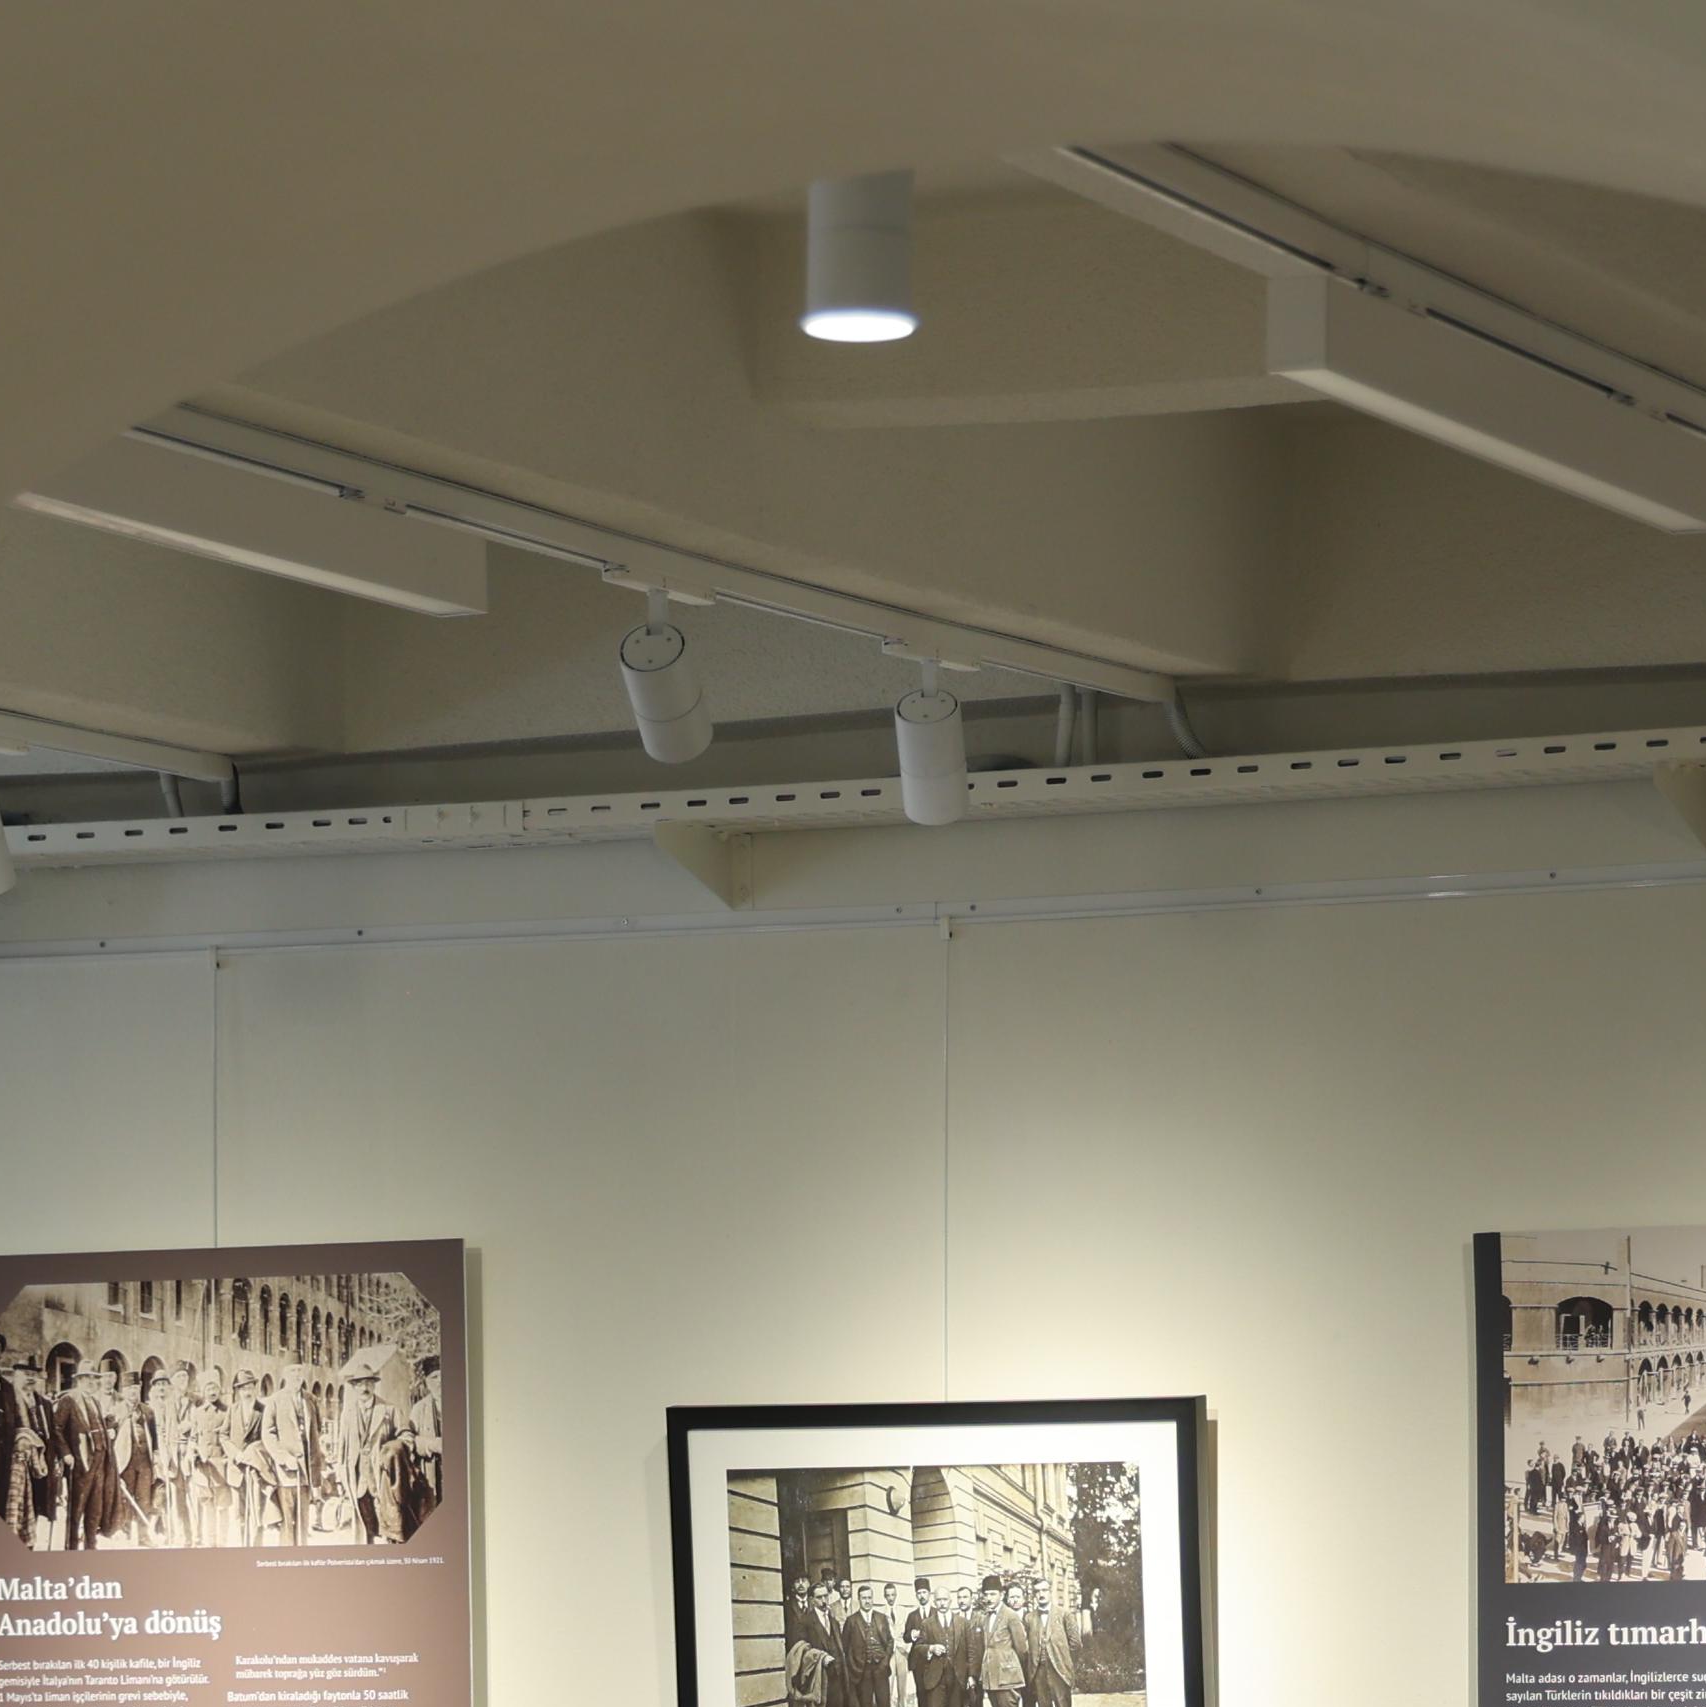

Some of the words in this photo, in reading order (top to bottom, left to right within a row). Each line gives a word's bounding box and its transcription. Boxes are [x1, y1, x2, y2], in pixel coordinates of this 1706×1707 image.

[143, 1608, 221, 1641] dönüş
[1506, 1615, 1601, 1653] İngiliz
[1505, 1673, 1537, 1683] Malta
[1537, 1672, 1567, 1683] adası
[1568, 1675, 1576, 1683] o
[1577, 1672, 1629, 1684] zamanlar,
[1629, 1669, 1690, 1685] İngilizlerce
[277, 1690, 322, 1704] kiraladığı
[321, 1690, 362, 1703] faytonla
[362, 1689, 377, 1700] 50
[377, 1689, 409, 1700] saatlik
